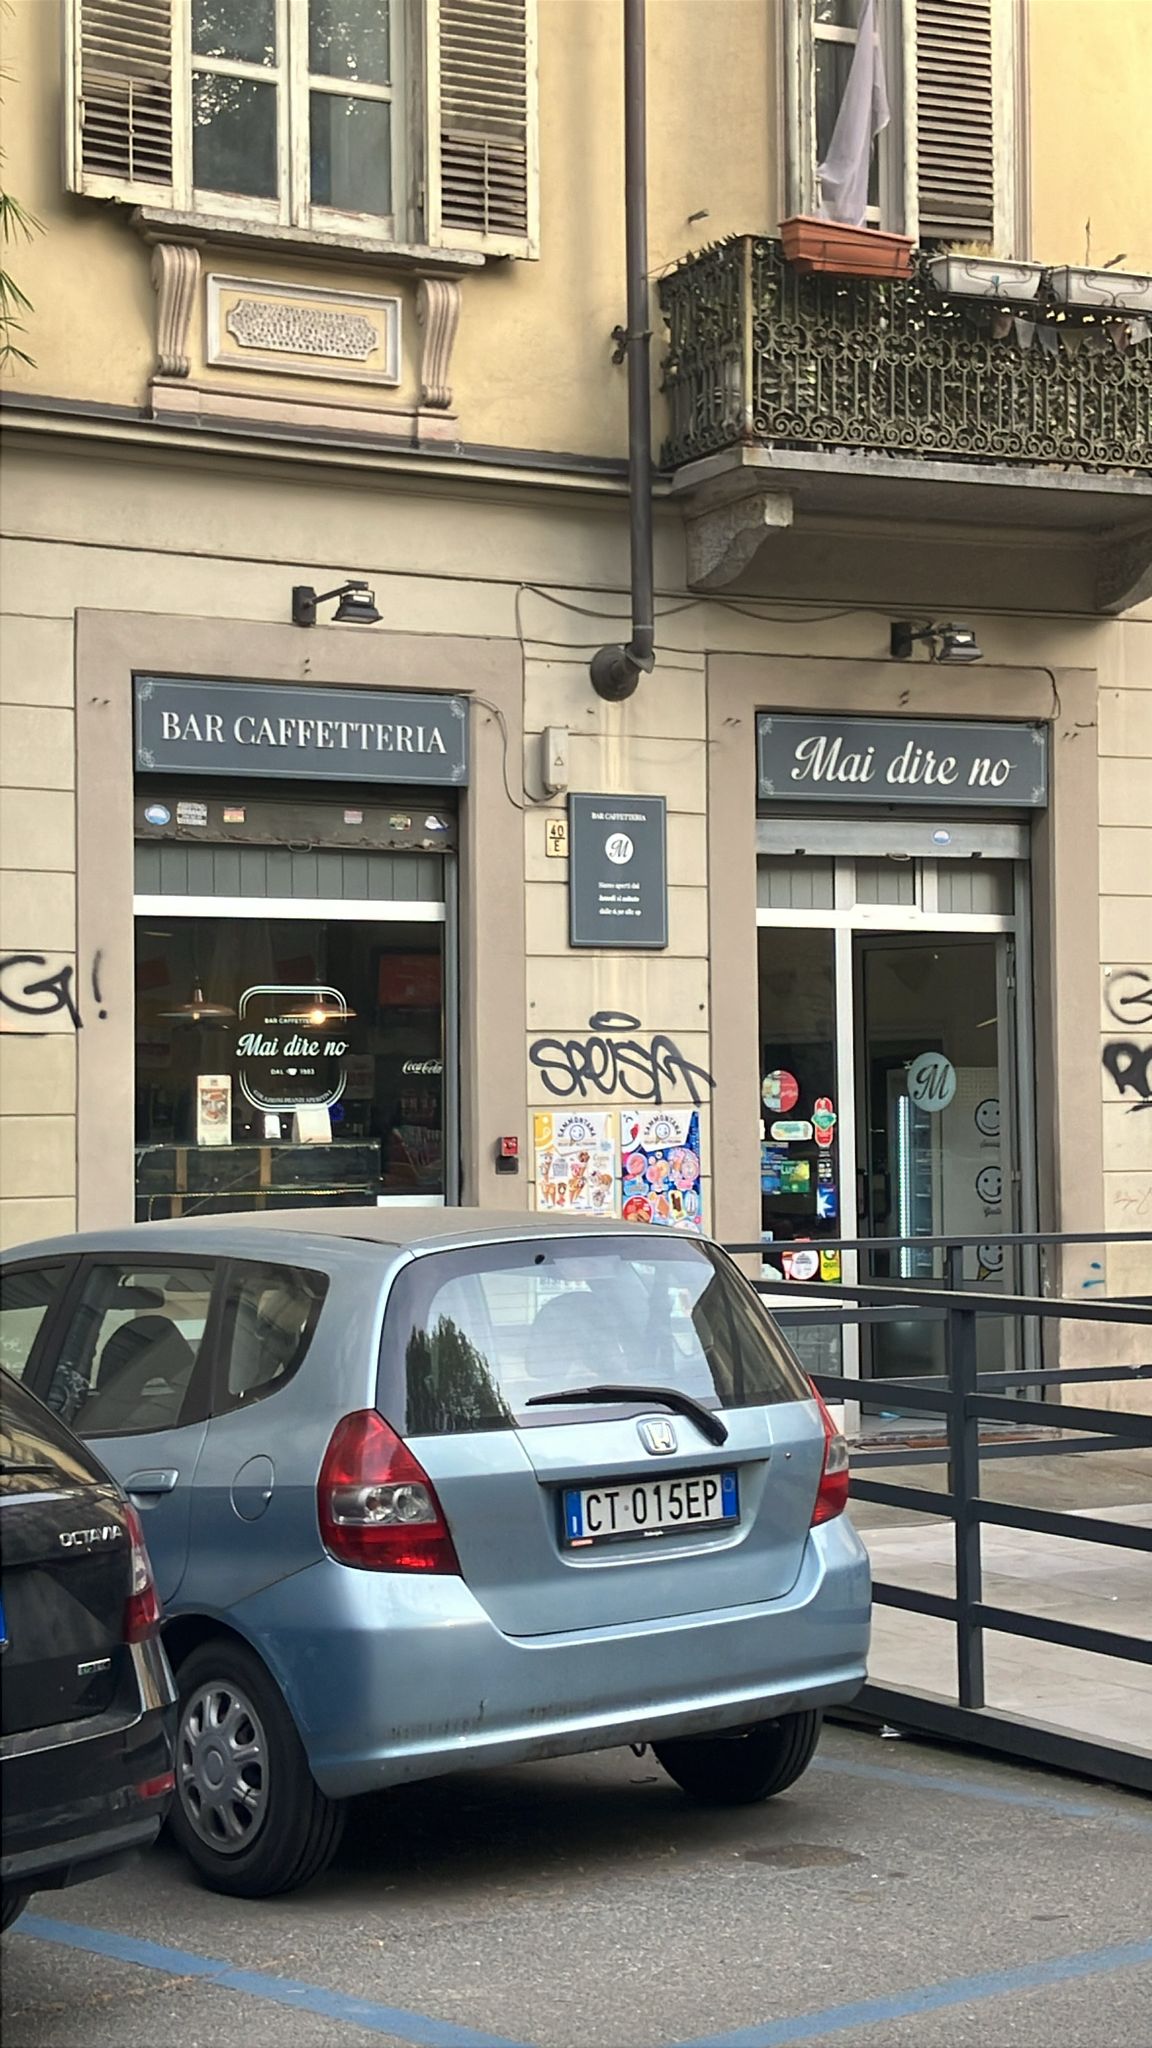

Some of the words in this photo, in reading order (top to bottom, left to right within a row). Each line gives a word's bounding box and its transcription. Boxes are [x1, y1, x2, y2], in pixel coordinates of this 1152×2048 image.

[161, 710, 225, 744] BAR
[233, 714, 448, 755] CAFFETTERIA
[790, 735, 876, 783] Mai
[886, 740, 959, 786] dire
[967, 756, 1018, 788] no
[591, 811, 604, 821] BAR
[604, 812, 647, 822] CAFFETTERIA
[549, 824, 565, 837] 40
[553, 839, 561, 853] E
[263, 1017, 278, 1025] BAR
[236, 1033, 280, 1057] Mai
[283, 1033, 321, 1057] dire
[323, 1040, 350, 1057] no
[557, 1116, 597, 1138] SAMMONTANA
[643, 1114, 682, 1136] SAMMONTANA
[586, 1492, 620, 1532] CT
[632, 1479, 719, 1525] 015EP
[59, 1525, 123, 1547] OCTAVIA
